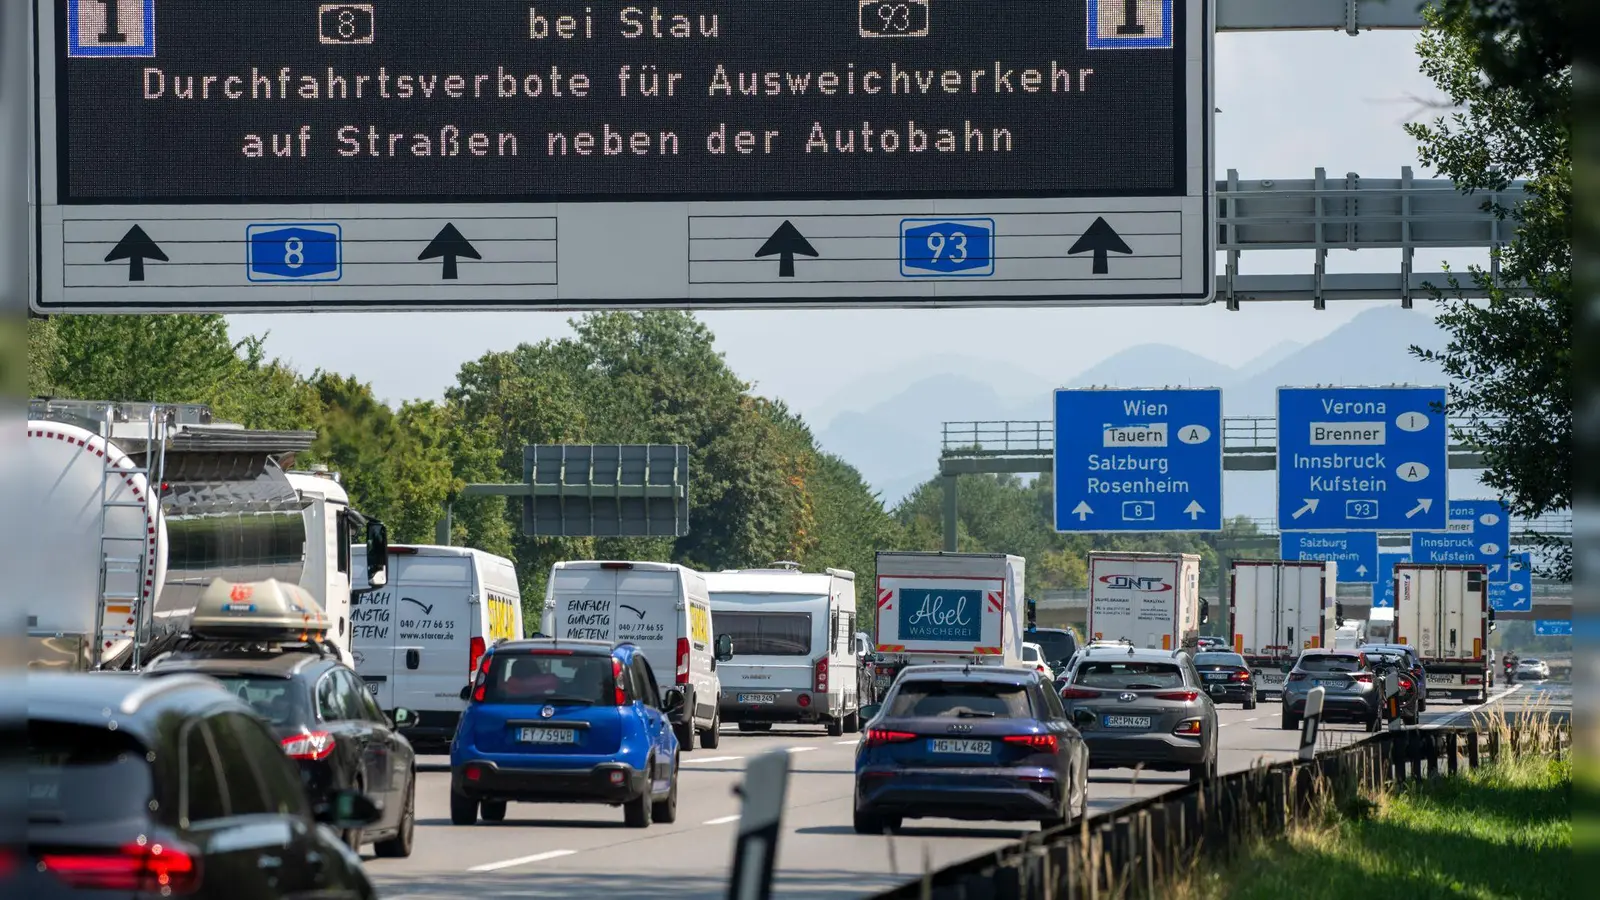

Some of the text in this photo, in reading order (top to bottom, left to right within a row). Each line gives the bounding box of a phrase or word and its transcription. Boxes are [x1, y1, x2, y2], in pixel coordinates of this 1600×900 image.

[338, 11, 354, 38] 8
[529, 6, 718, 39] bei Stau
[878, 4, 909, 31] 93
[143, 61, 1094, 99] Durchfahrtsverbote für Ausweichverkehr
[242, 120, 1013, 158] auf Straßen neben der Autobahn
[284, 236, 304, 269] 8
[927, 231, 968, 263] 93
[1123, 400, 1168, 416] Wien
[1321, 399, 1386, 415] Verona
[1109, 428, 1199, 442] Tauern A
[1315, 428, 1380, 441] Brenner
[1088, 454, 1169, 474] Salzburg
[1294, 453, 1386, 468] Innsbruck
[1408, 466, 1417, 478] A
[1088, 477, 1189, 494] Rosenheim
[1310, 475, 1386, 492] Kufstein
[1135, 505, 1143, 517] 8
[1354, 503, 1370, 516] 93
[1450, 508, 1475, 516] rona
[1300, 538, 1347, 549] Salzburg
[1420, 538, 1474, 547] Innsbruck
[1299, 551, 1359, 561] Rosenheim
[1430, 551, 1475, 562] Kufstein
[360, 592, 390, 604] FACH
[909, 594, 971, 625] Abel
[400, 620, 414, 628] 040
[422, 620, 432, 628] 77
[433, 620, 443, 628] 66
[445, 620, 454, 629] 55
[353, 625, 388, 639] ETEN!
[934, 740, 948, 751] HG
[954, 742, 969, 752] LY
